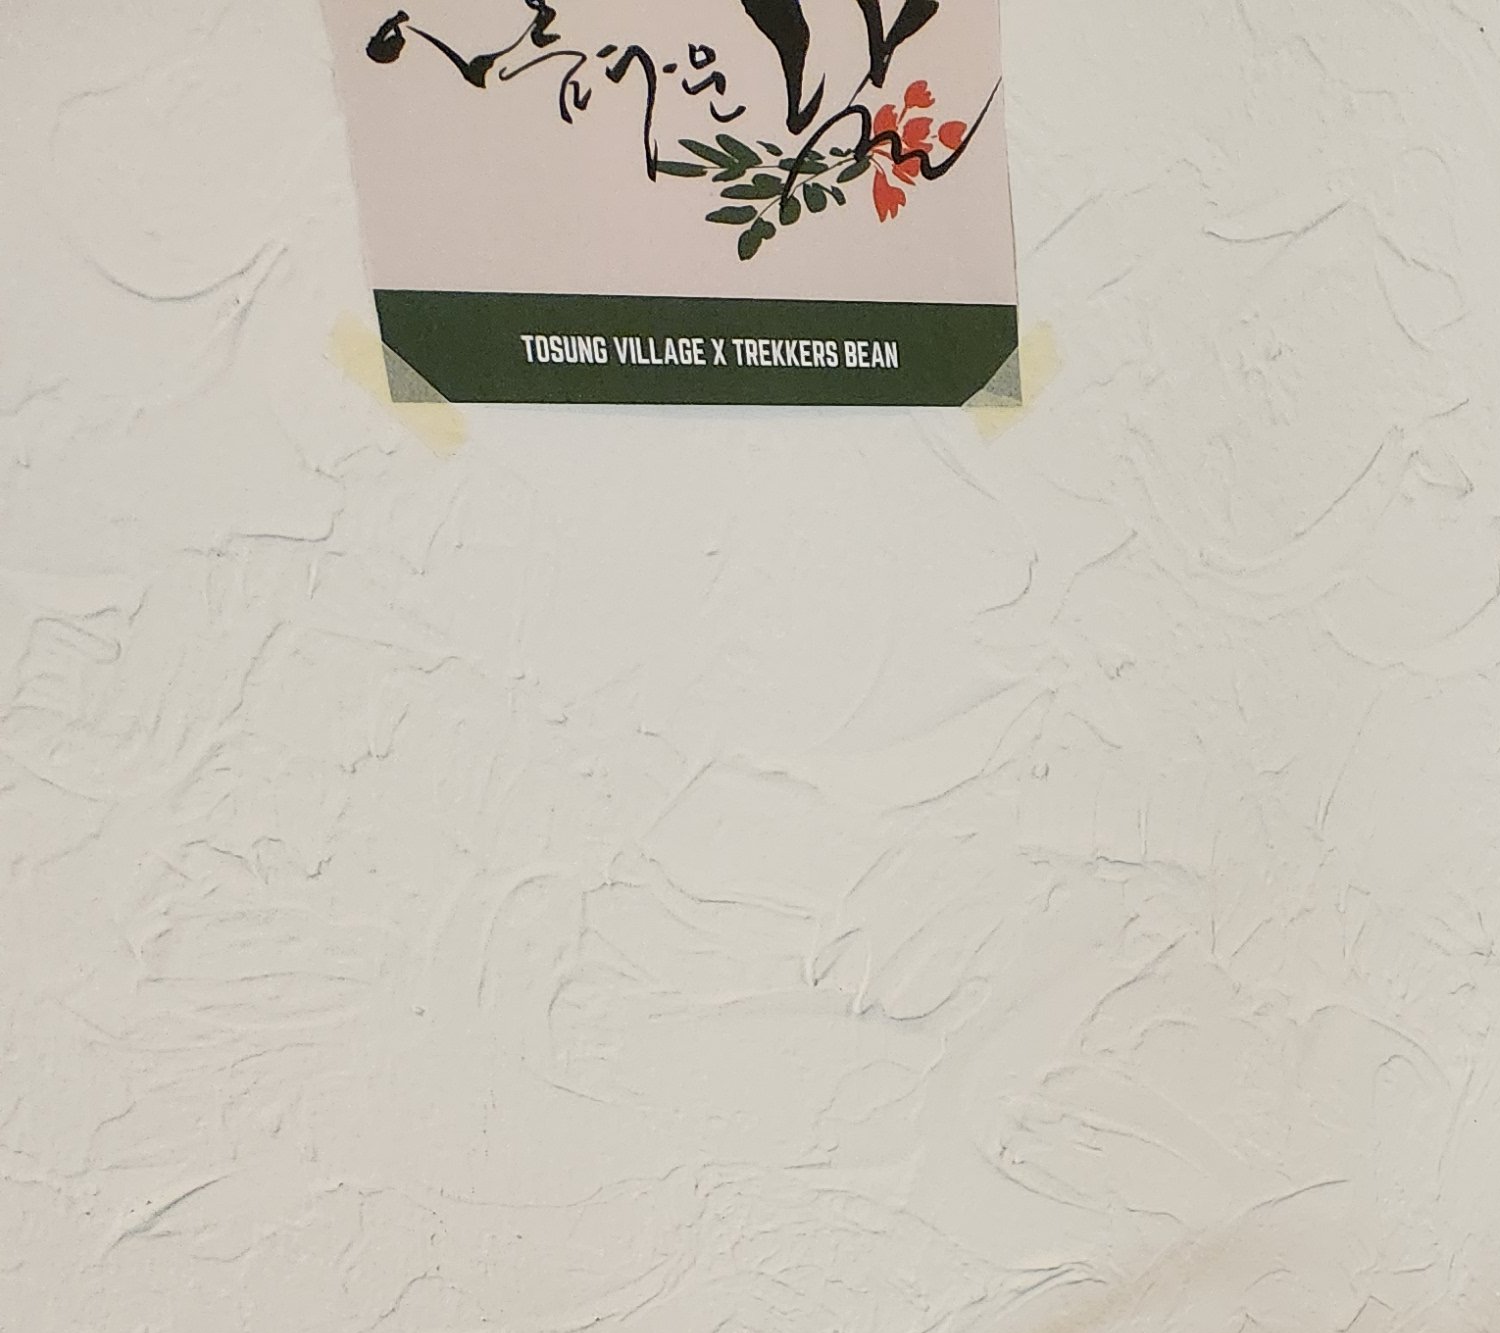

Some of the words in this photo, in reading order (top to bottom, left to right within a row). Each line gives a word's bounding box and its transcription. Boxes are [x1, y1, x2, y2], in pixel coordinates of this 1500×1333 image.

[520, 334, 607, 364] TOSUNG
[612, 337, 706, 365] VILLAGE
[712, 338, 727, 365] X
[732, 338, 838, 367] TREKKERS
[844, 341, 899, 369] BEAN
